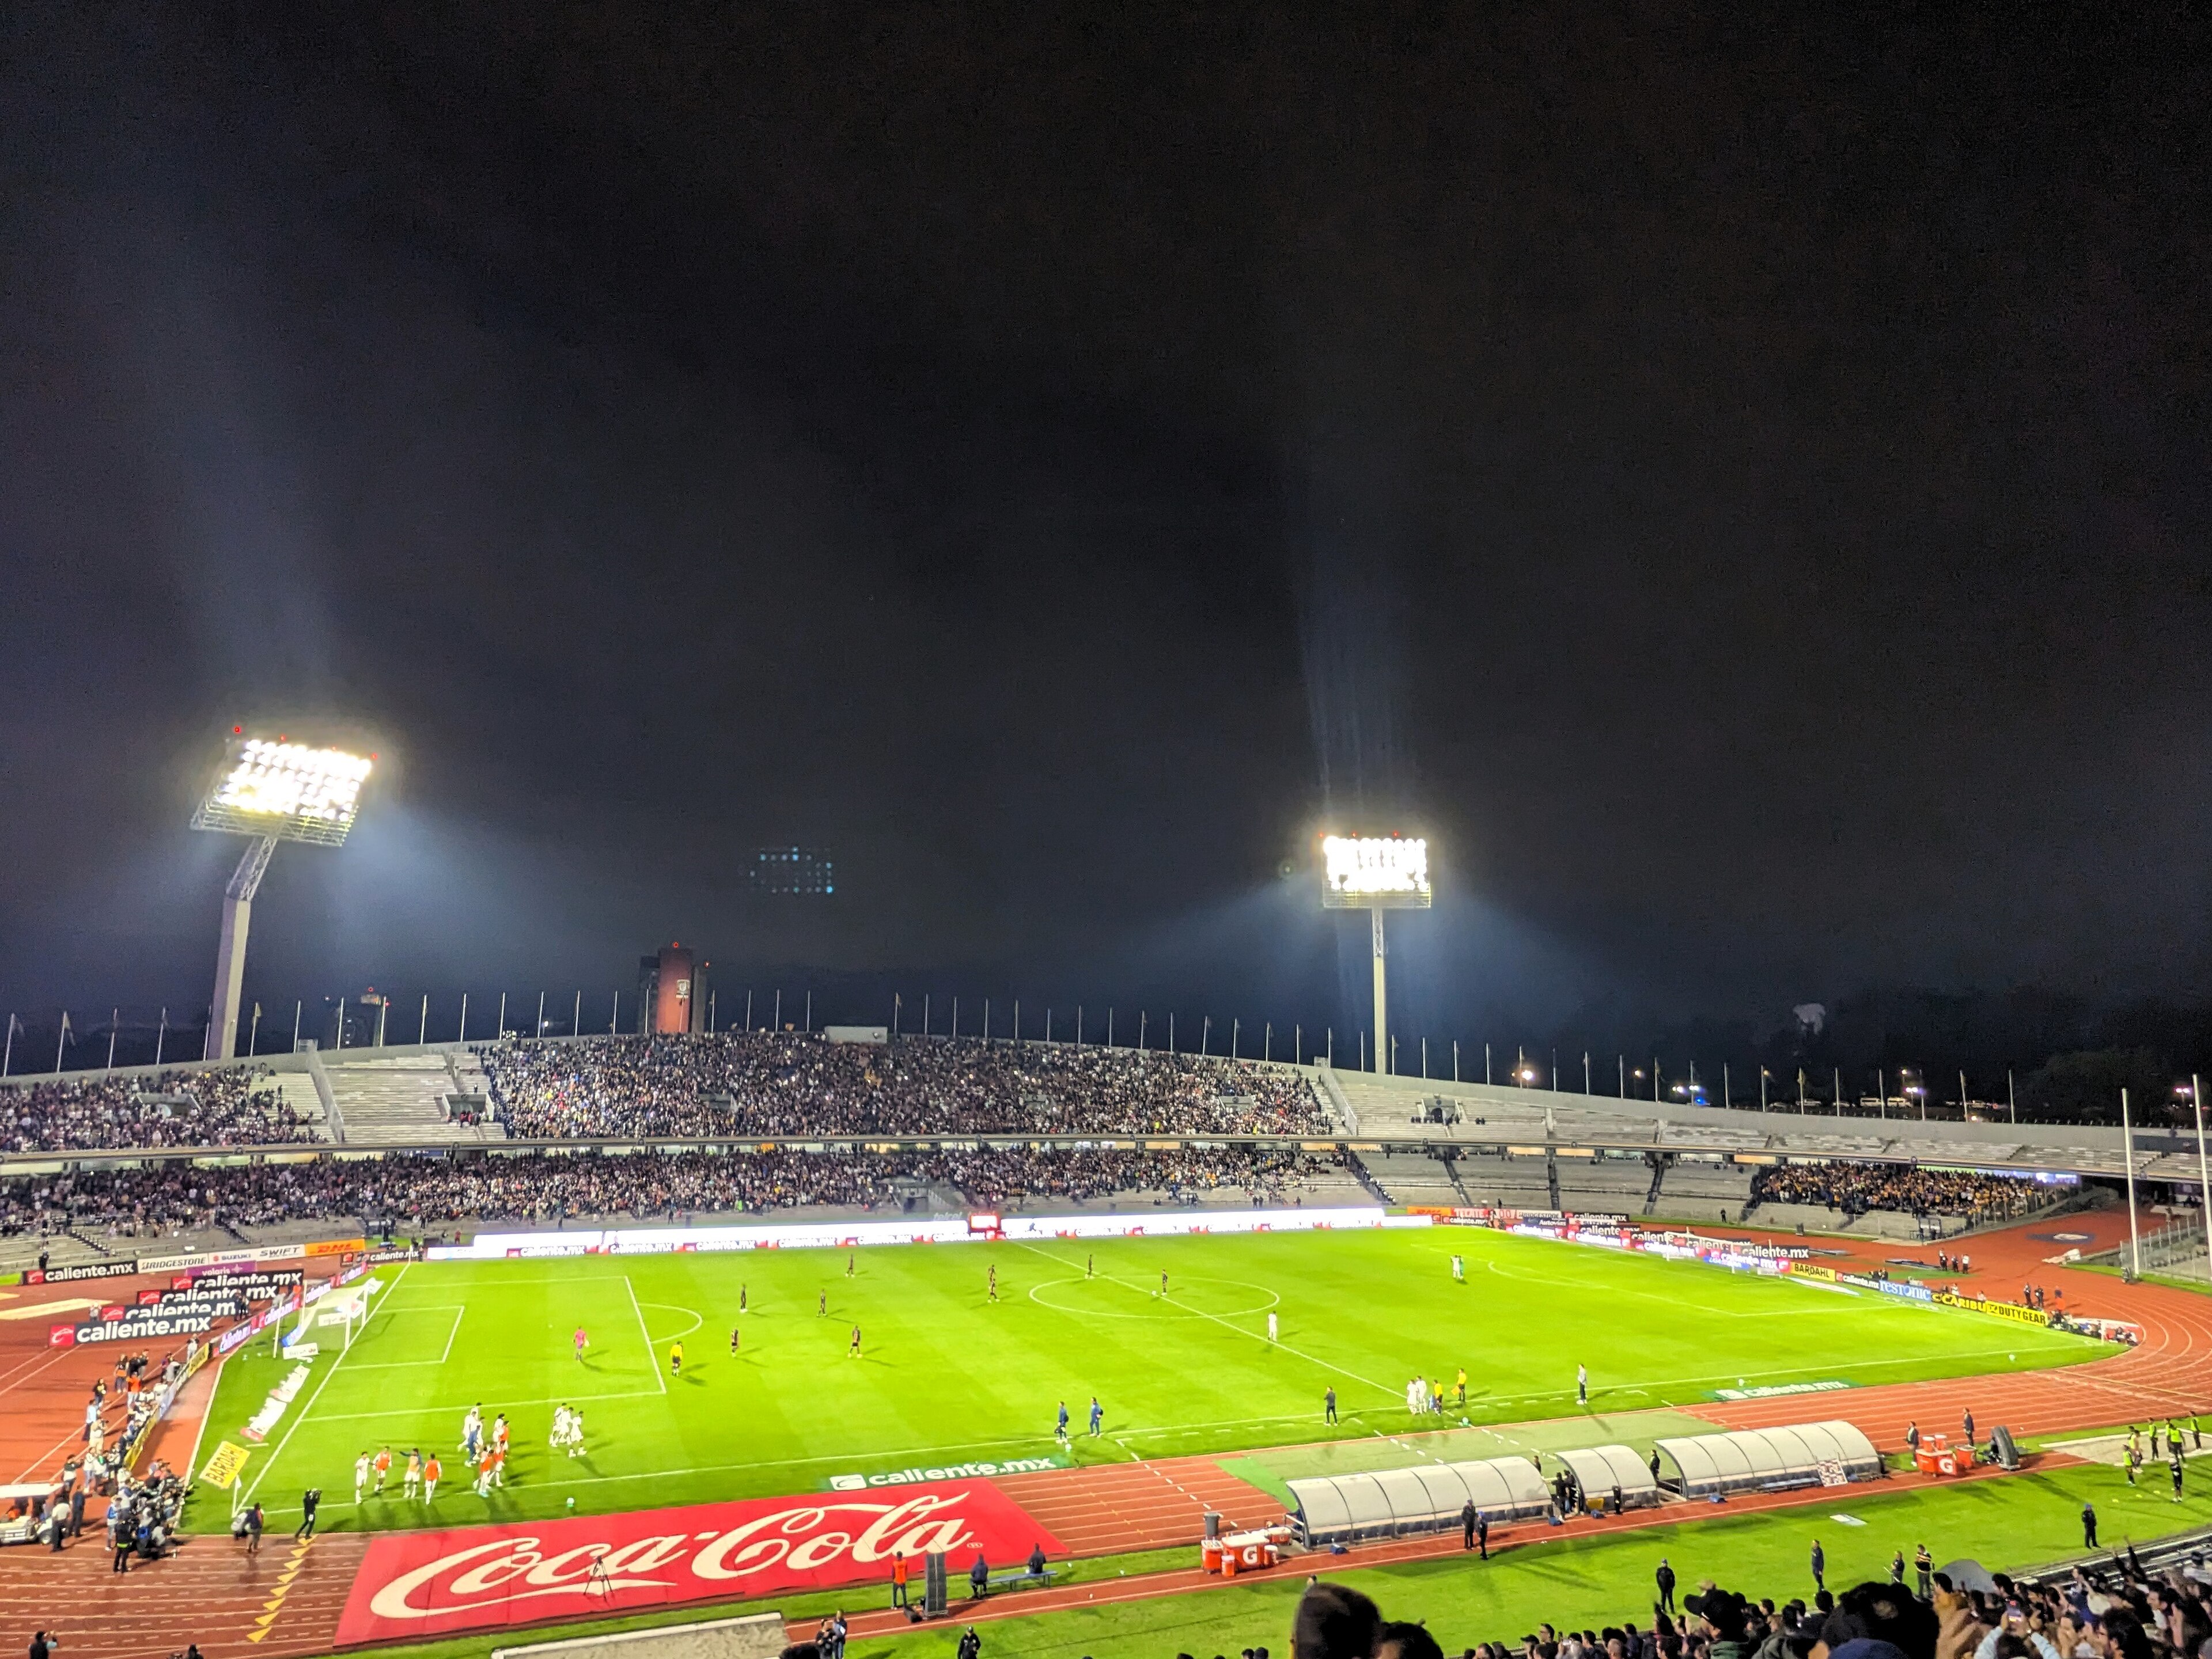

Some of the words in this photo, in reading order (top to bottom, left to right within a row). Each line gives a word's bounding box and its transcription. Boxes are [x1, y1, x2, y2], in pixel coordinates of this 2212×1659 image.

[45, 1263, 134, 1282] caliente.mx
[1794, 1263, 1830, 1278] BARDAHL
[1941, 1294, 1986, 1312] CARIBU
[1999, 1306, 2021, 1319] DUTY
[2022, 1313, 2046, 1325] GEAR
[76, 1316, 211, 1343] caliente.mx
[868, 1457, 1056, 1486] caliente.mx
[1939, 1459, 1953, 1474] G
[369, 1490, 973, 1620] Coca-Cola
[1243, 1546, 1257, 1565] G
